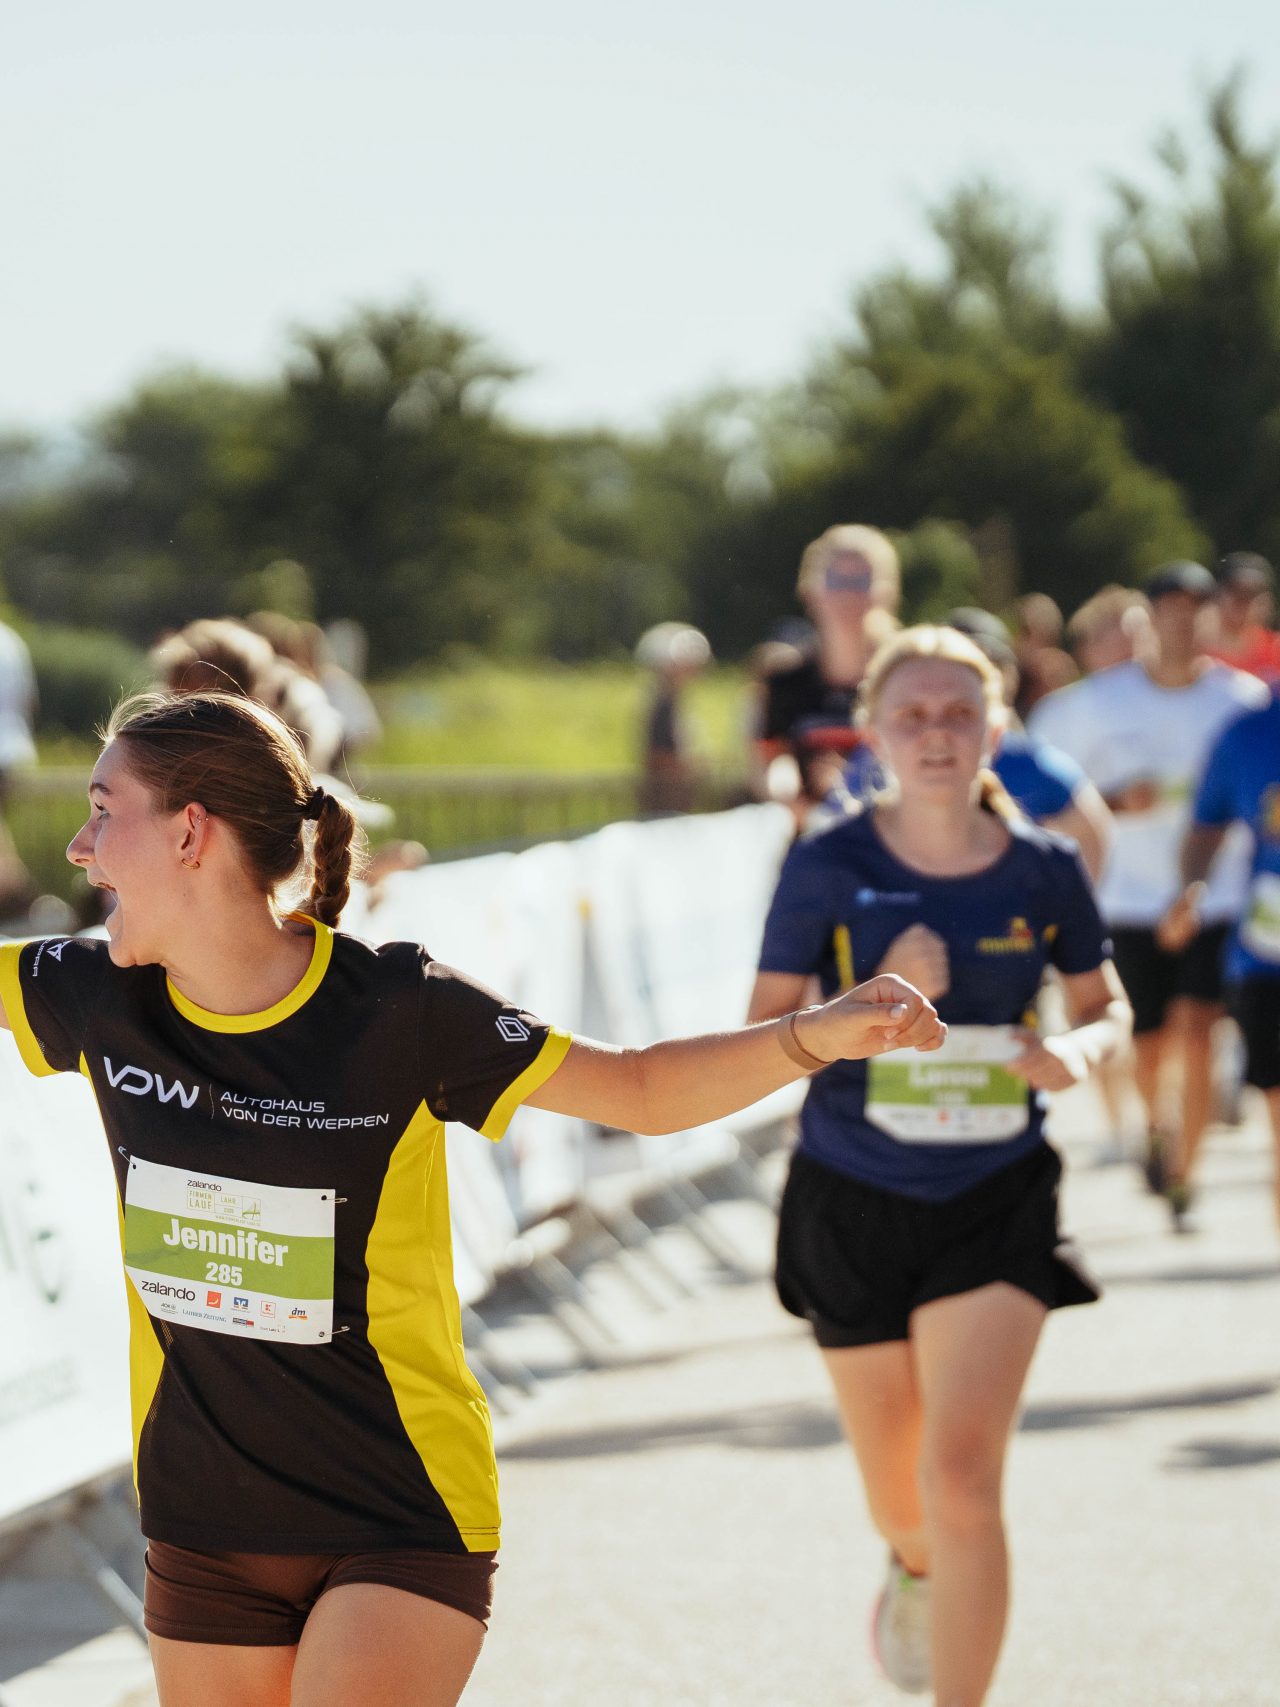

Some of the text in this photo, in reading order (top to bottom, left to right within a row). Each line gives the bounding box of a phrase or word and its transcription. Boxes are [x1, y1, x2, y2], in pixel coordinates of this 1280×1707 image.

[104, 1056, 200, 1110] VDW
[220, 1091, 325, 1113] AUTOHAUS
[222, 1106, 390, 1131] VON DER WEPPEN
[187, 1179, 222, 1192] zalando
[163, 1218, 289, 1267] Jennifer
[205, 1262, 243, 1286] 285
[141, 1280, 196, 1302] zalando
[291, 1307, 306, 1316] dm
